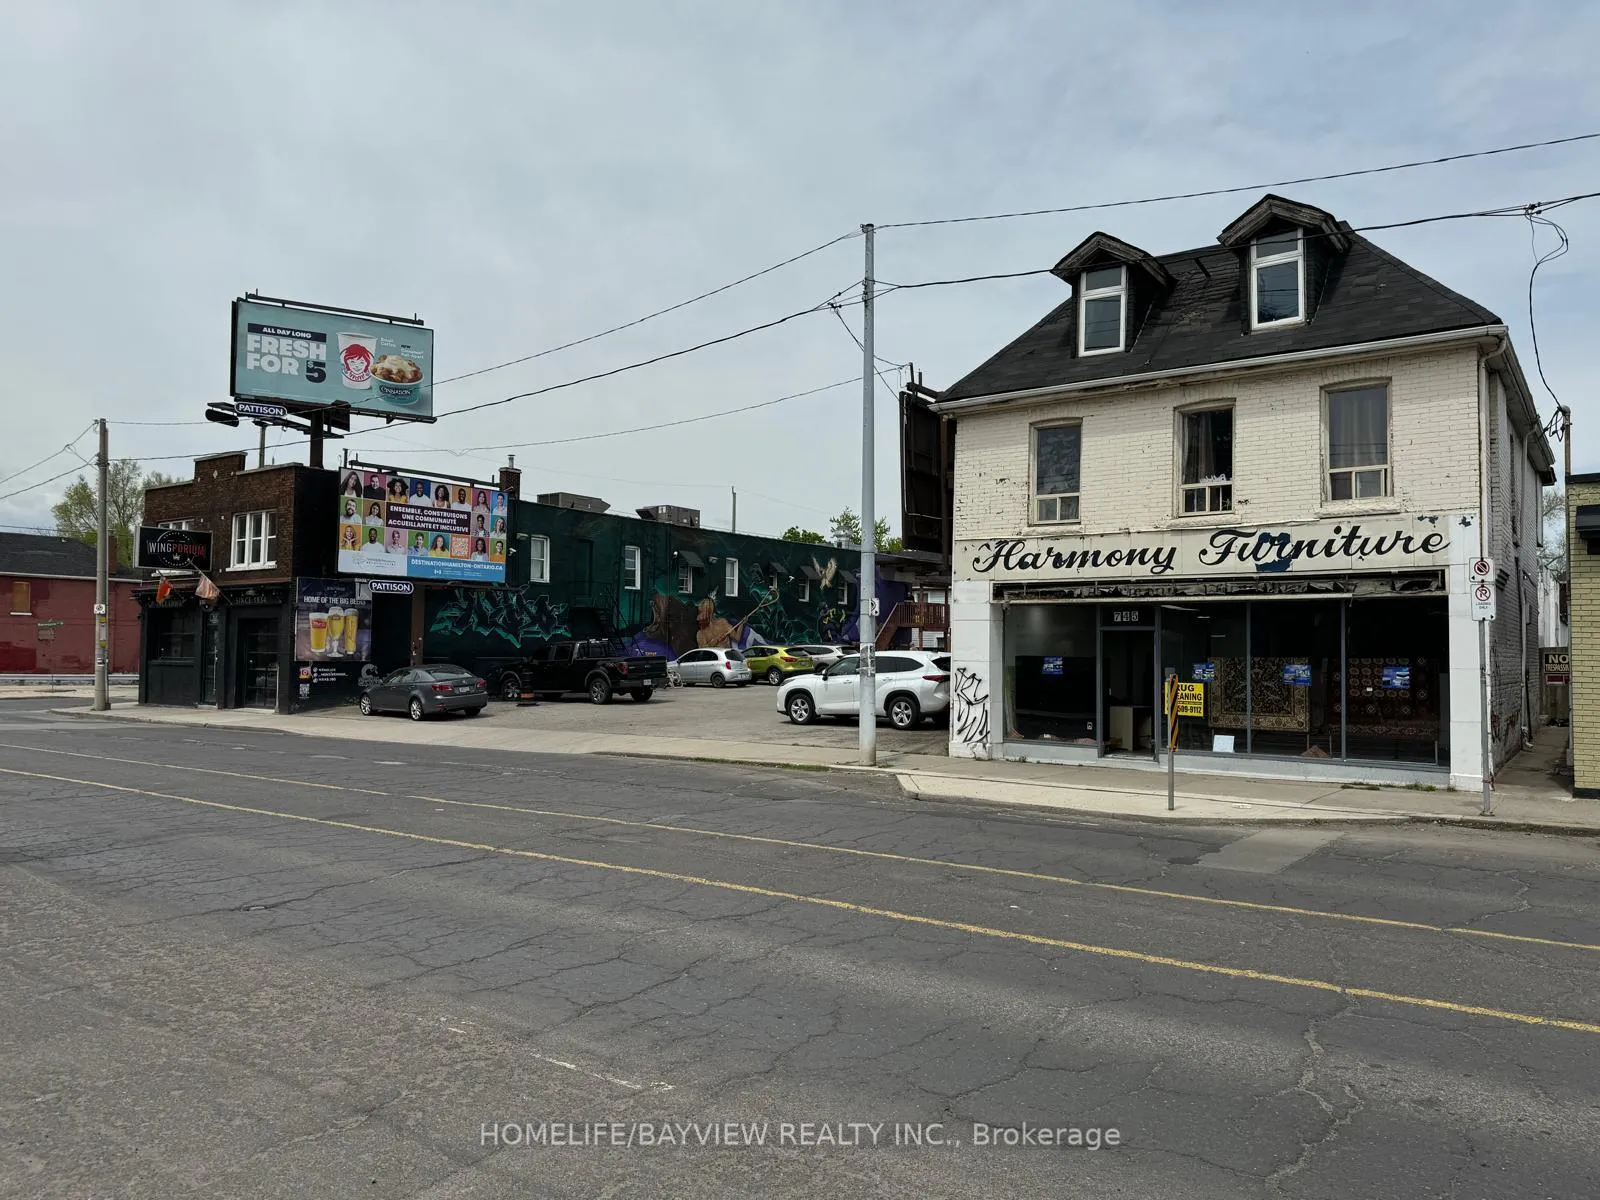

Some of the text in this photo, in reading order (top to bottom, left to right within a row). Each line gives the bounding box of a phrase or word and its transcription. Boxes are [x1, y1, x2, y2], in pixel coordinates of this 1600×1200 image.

[246, 334, 327, 361] FRESH
[246, 352, 300, 376] FOR
[238, 404, 283, 415] PATTISON
[390, 505, 468, 520] ENSEMBLE, CONSTRUISONS
[388, 519, 432, 529] ACCUEILLANTE
[440, 524, 469, 533] INCLUSIVE
[972, 525, 1450, 574] Harmony Furniture
[371, 582, 411, 592] PATTISON
[1548, 654, 1569, 664] NO
